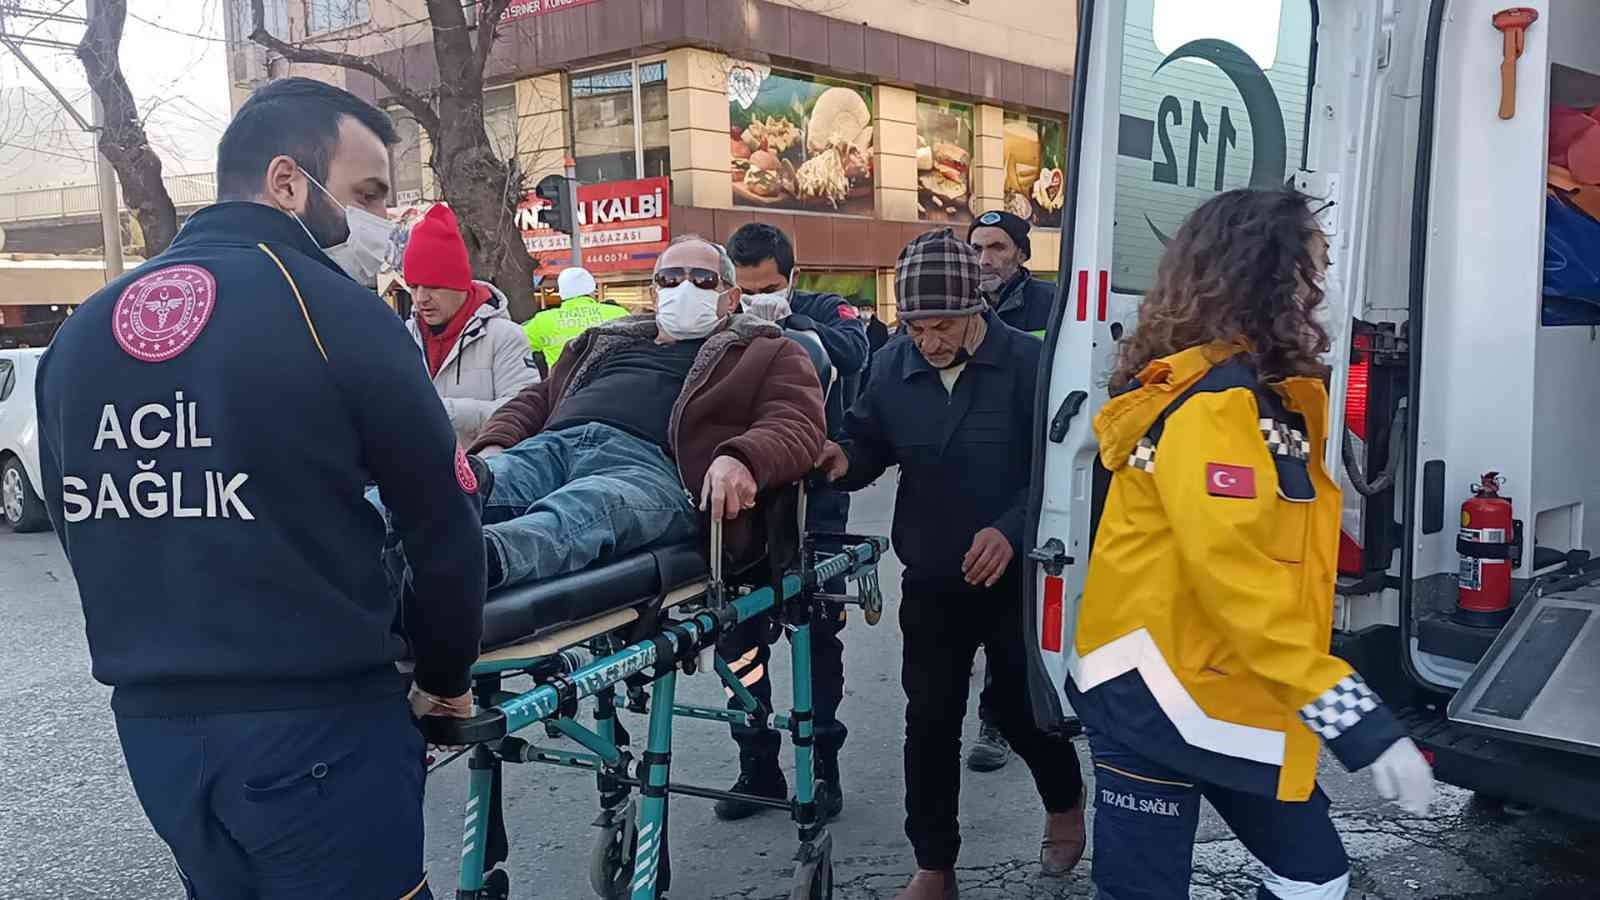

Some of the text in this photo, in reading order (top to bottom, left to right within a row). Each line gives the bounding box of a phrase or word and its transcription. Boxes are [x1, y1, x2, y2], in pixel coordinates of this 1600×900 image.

[592, 187, 662, 225] KALBİ
[93, 391, 212, 450] ACİL
[63, 459, 256, 523] SAĞLIK
[1115, 793, 1138, 811] ACİL
[1140, 798, 1180, 817] SAĞLIK
